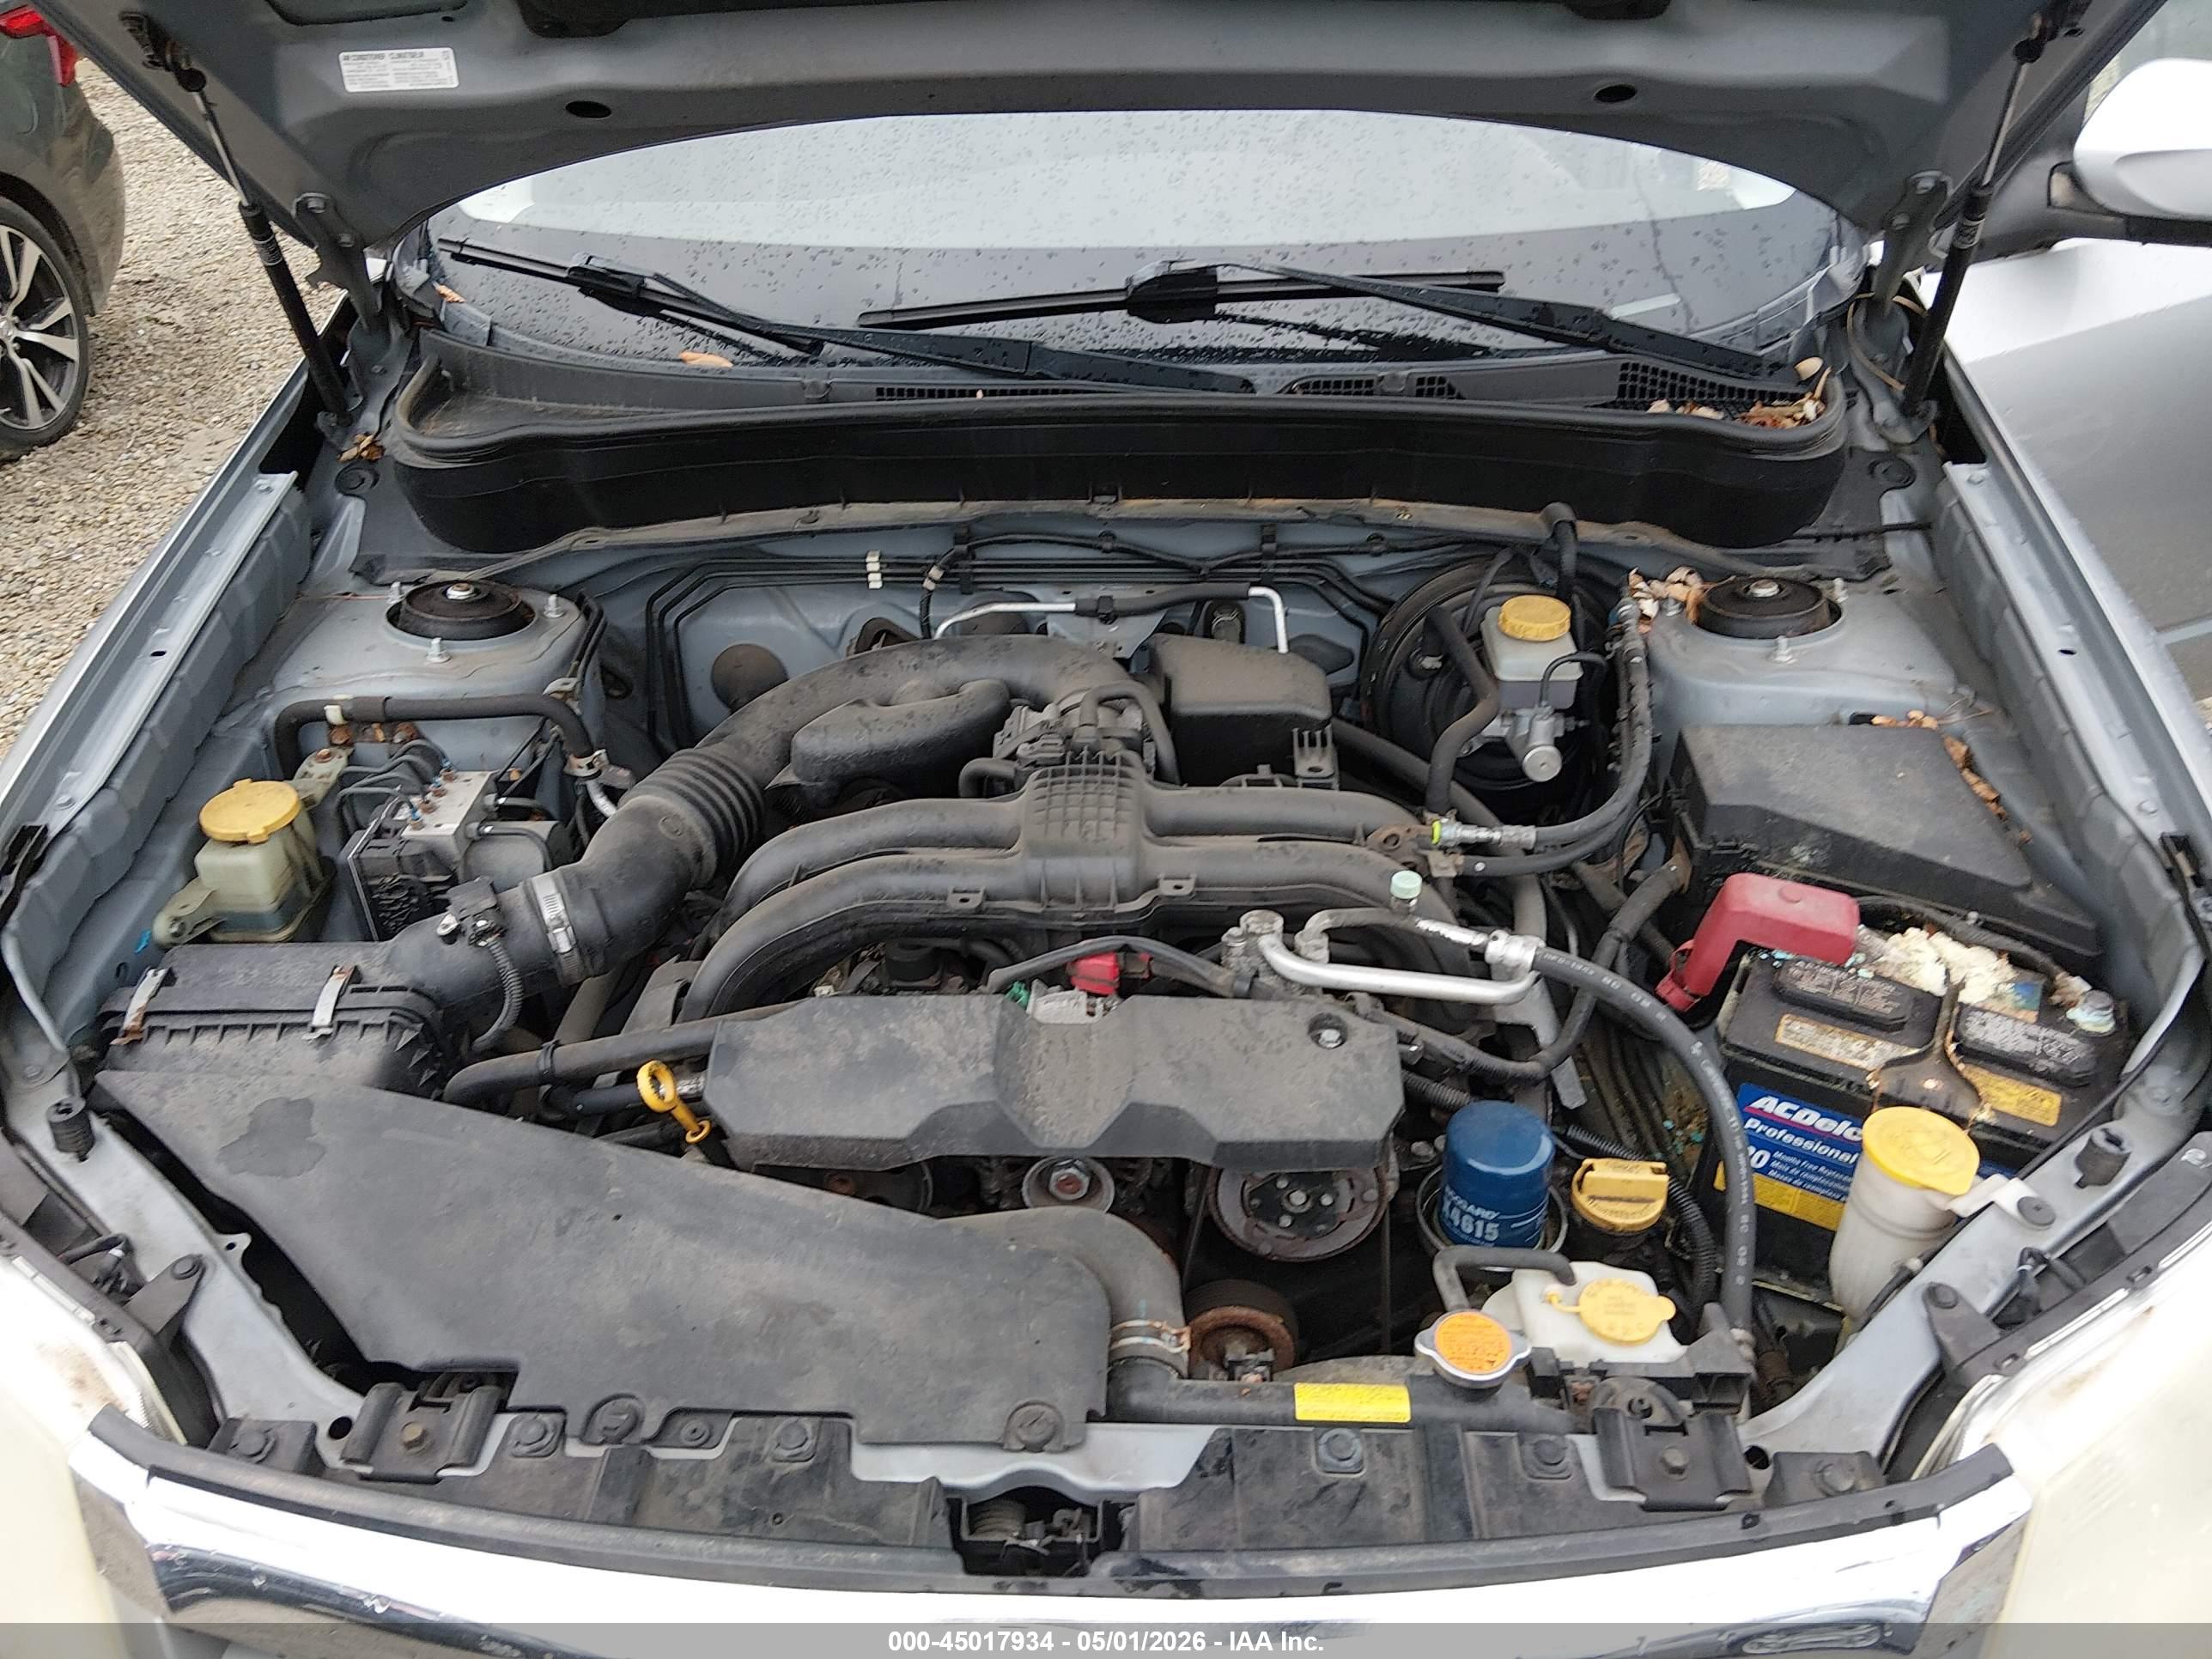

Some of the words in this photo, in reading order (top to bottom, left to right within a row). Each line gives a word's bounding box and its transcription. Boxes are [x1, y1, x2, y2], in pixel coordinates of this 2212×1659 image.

[1744, 1117, 1860, 1164] Professional
[1749, 1095, 1863, 1142] ACDelc
[1772, 1151, 1802, 1166] Months
[1800, 1157, 1819, 1171] Free
